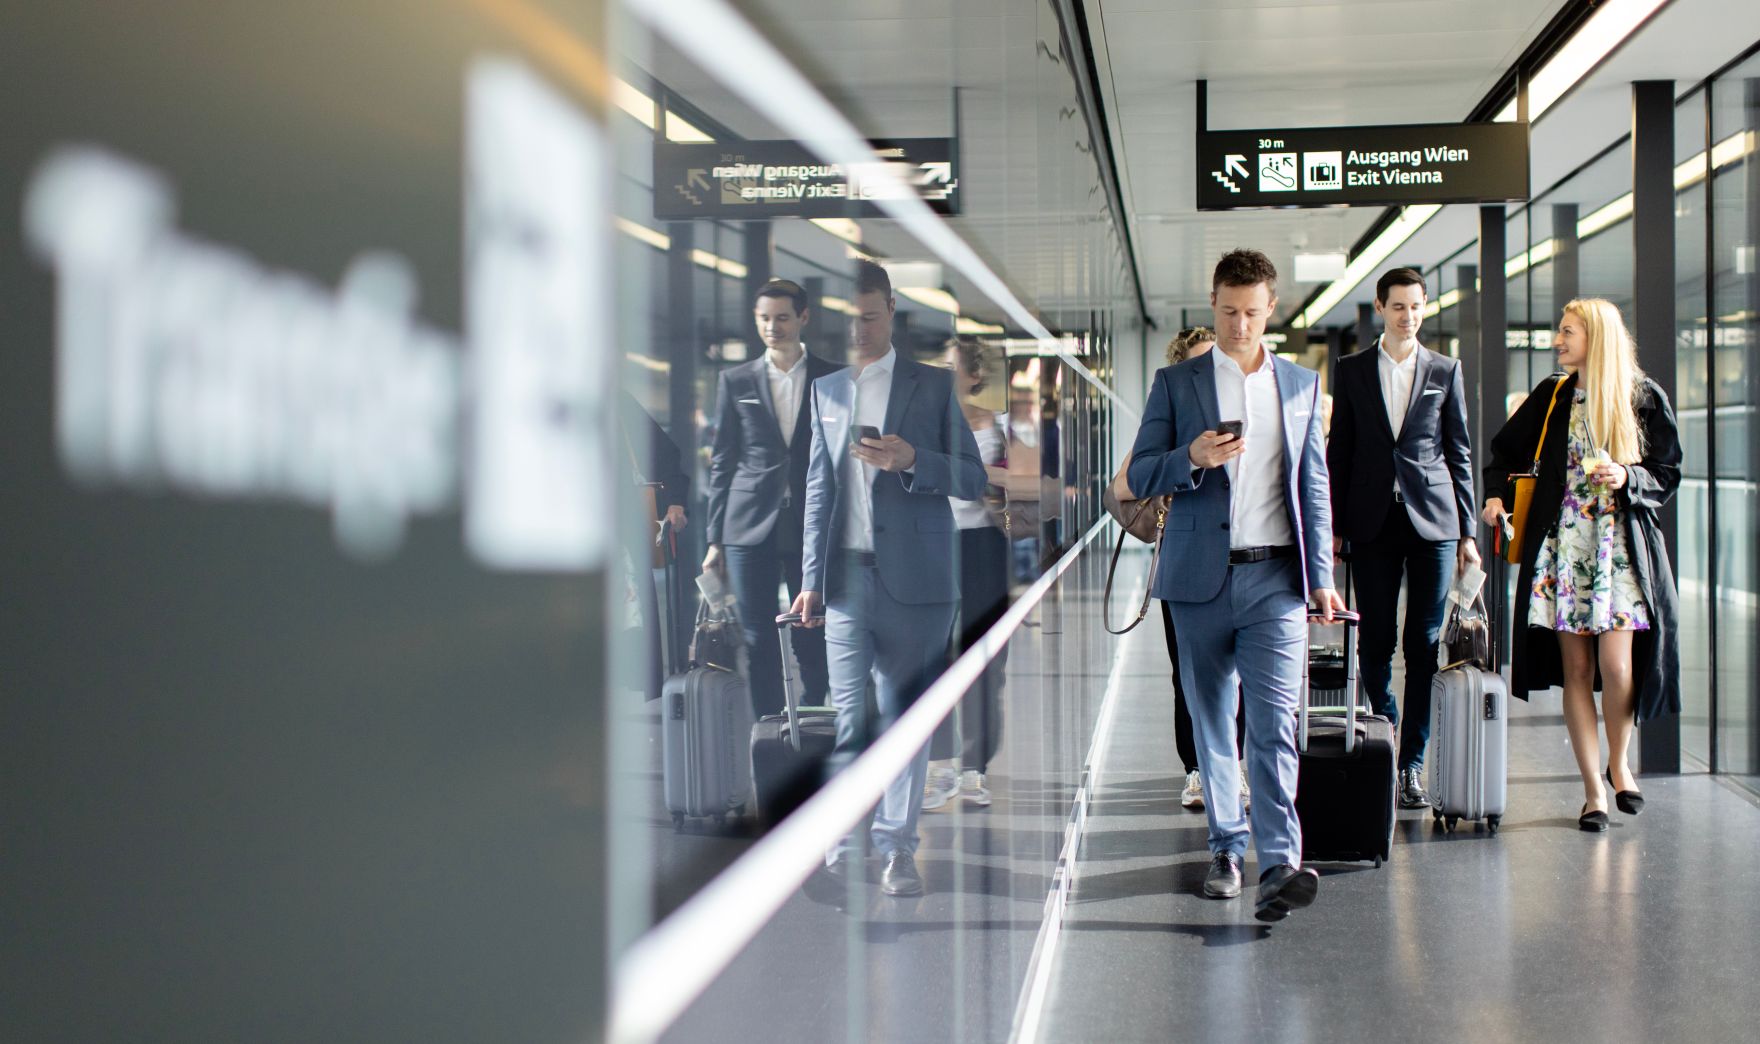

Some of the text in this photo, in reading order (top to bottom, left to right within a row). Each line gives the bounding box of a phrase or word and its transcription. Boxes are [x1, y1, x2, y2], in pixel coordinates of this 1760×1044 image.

[1258, 139, 1285, 149] 30 m
[1346, 145, 1469, 167] Ausgang Wien
[1347, 168, 1443, 186] Exit Vienna
